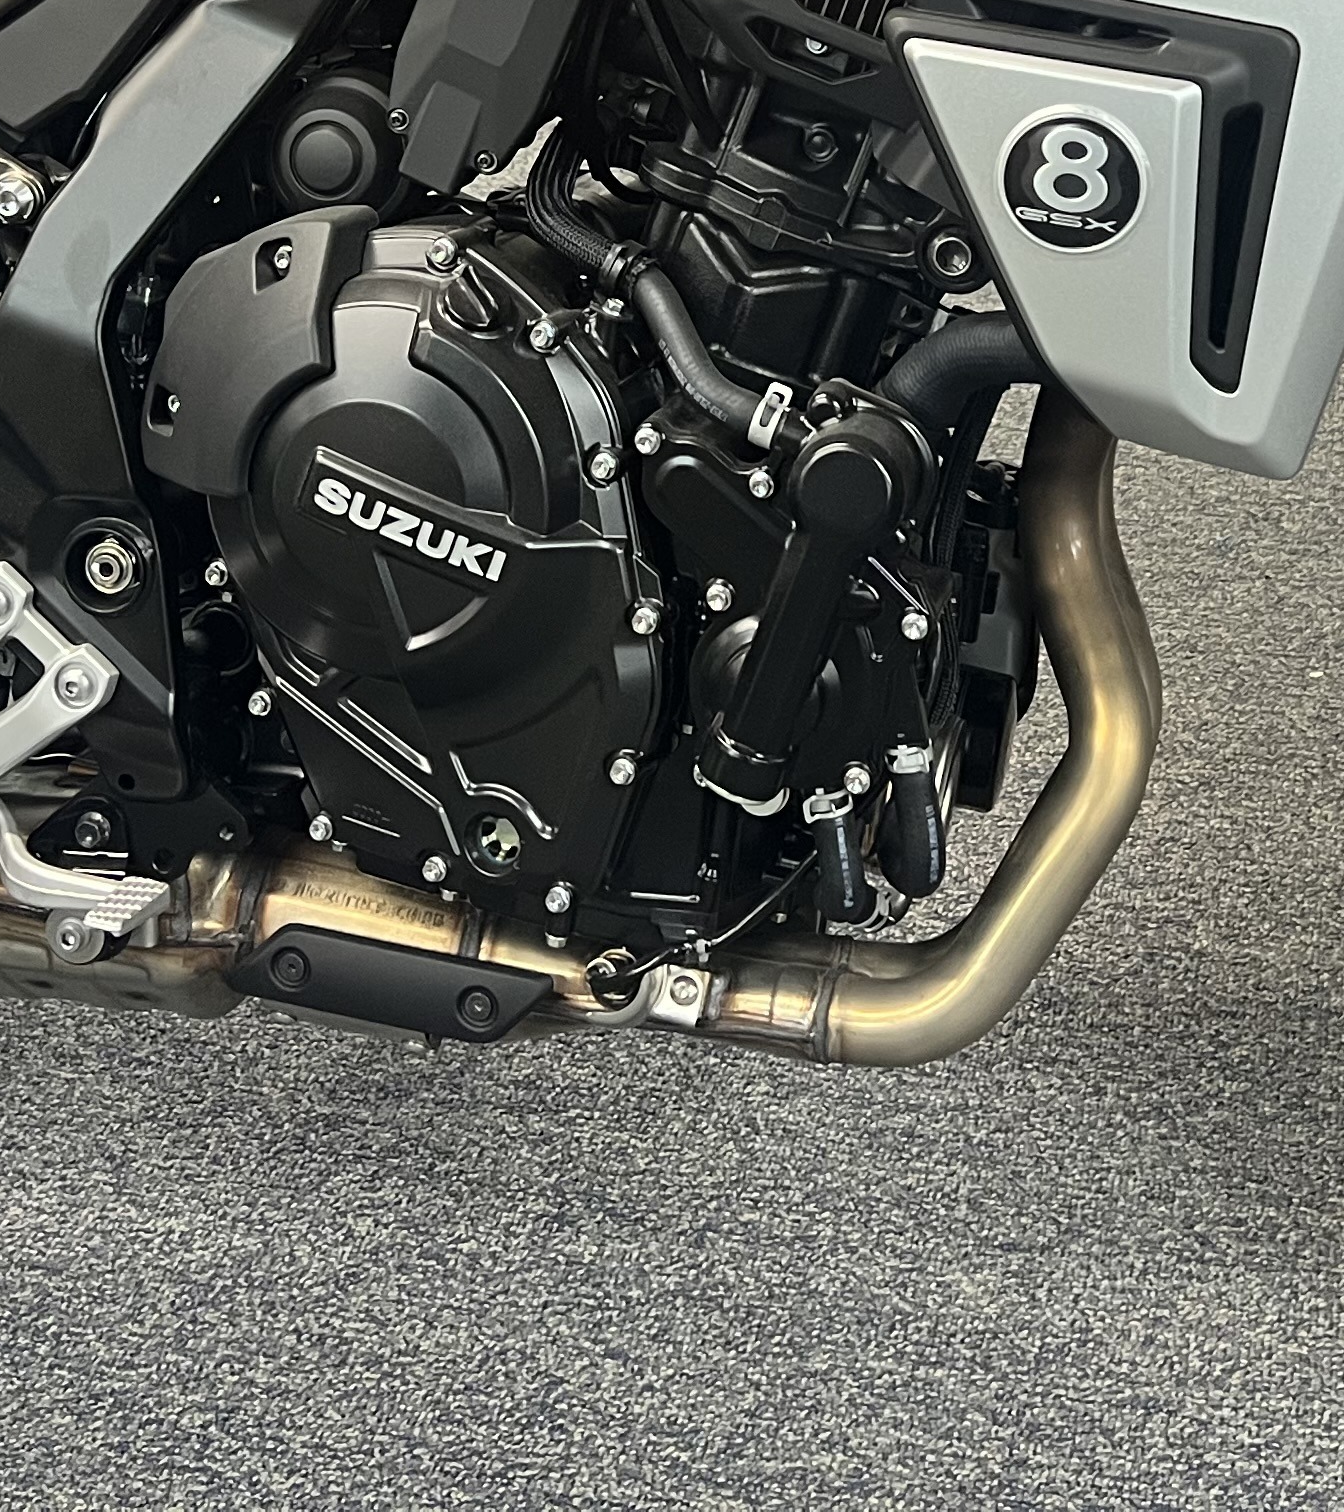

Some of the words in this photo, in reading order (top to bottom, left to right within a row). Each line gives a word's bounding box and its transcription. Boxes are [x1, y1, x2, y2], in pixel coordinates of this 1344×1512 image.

[1033, 123, 1109, 213] 8
[1015, 206, 1117, 233] GSX
[314, 478, 507, 582] SUZUKI
